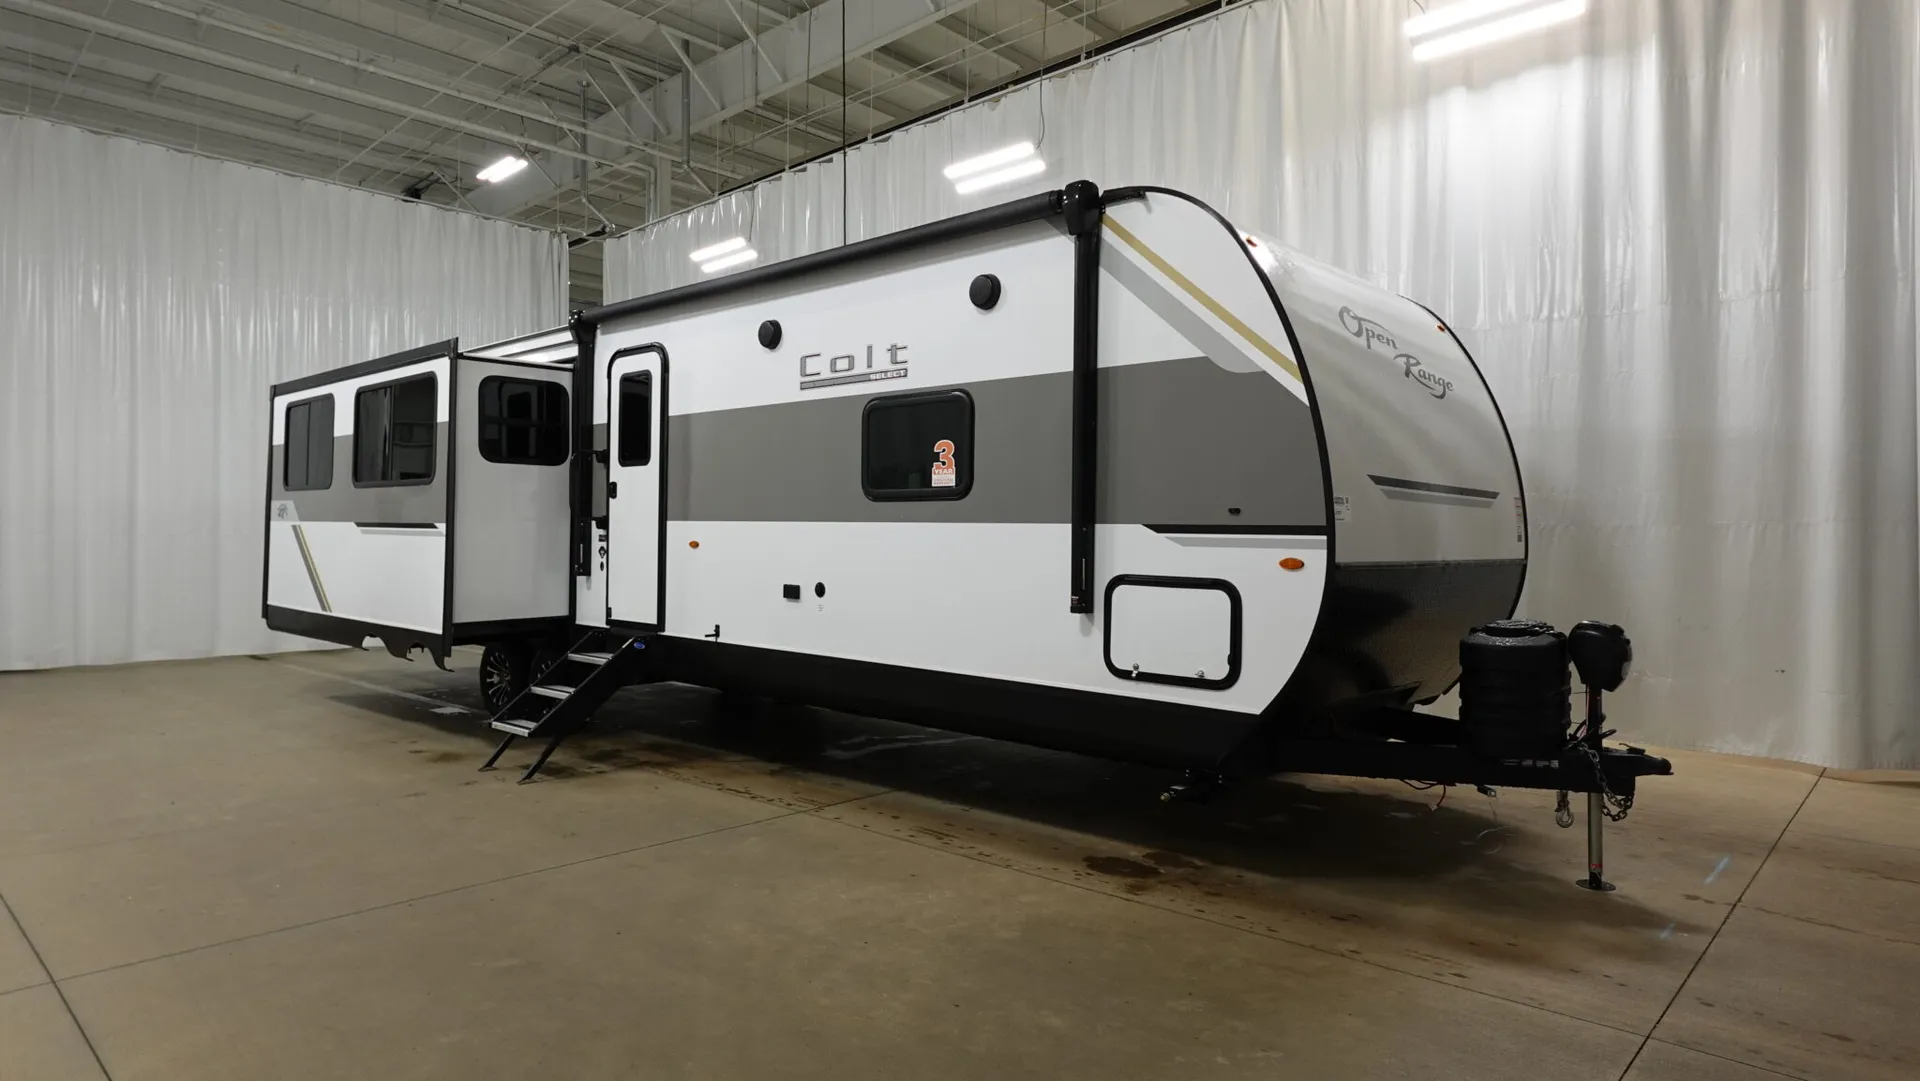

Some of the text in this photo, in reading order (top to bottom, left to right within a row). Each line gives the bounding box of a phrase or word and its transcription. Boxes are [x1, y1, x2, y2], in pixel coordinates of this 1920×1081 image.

[800, 344, 908, 377] Colt
[1338, 306, 1454, 400] Open Range
[869, 369, 906, 381] SELECT
[933, 439, 955, 470] 3
